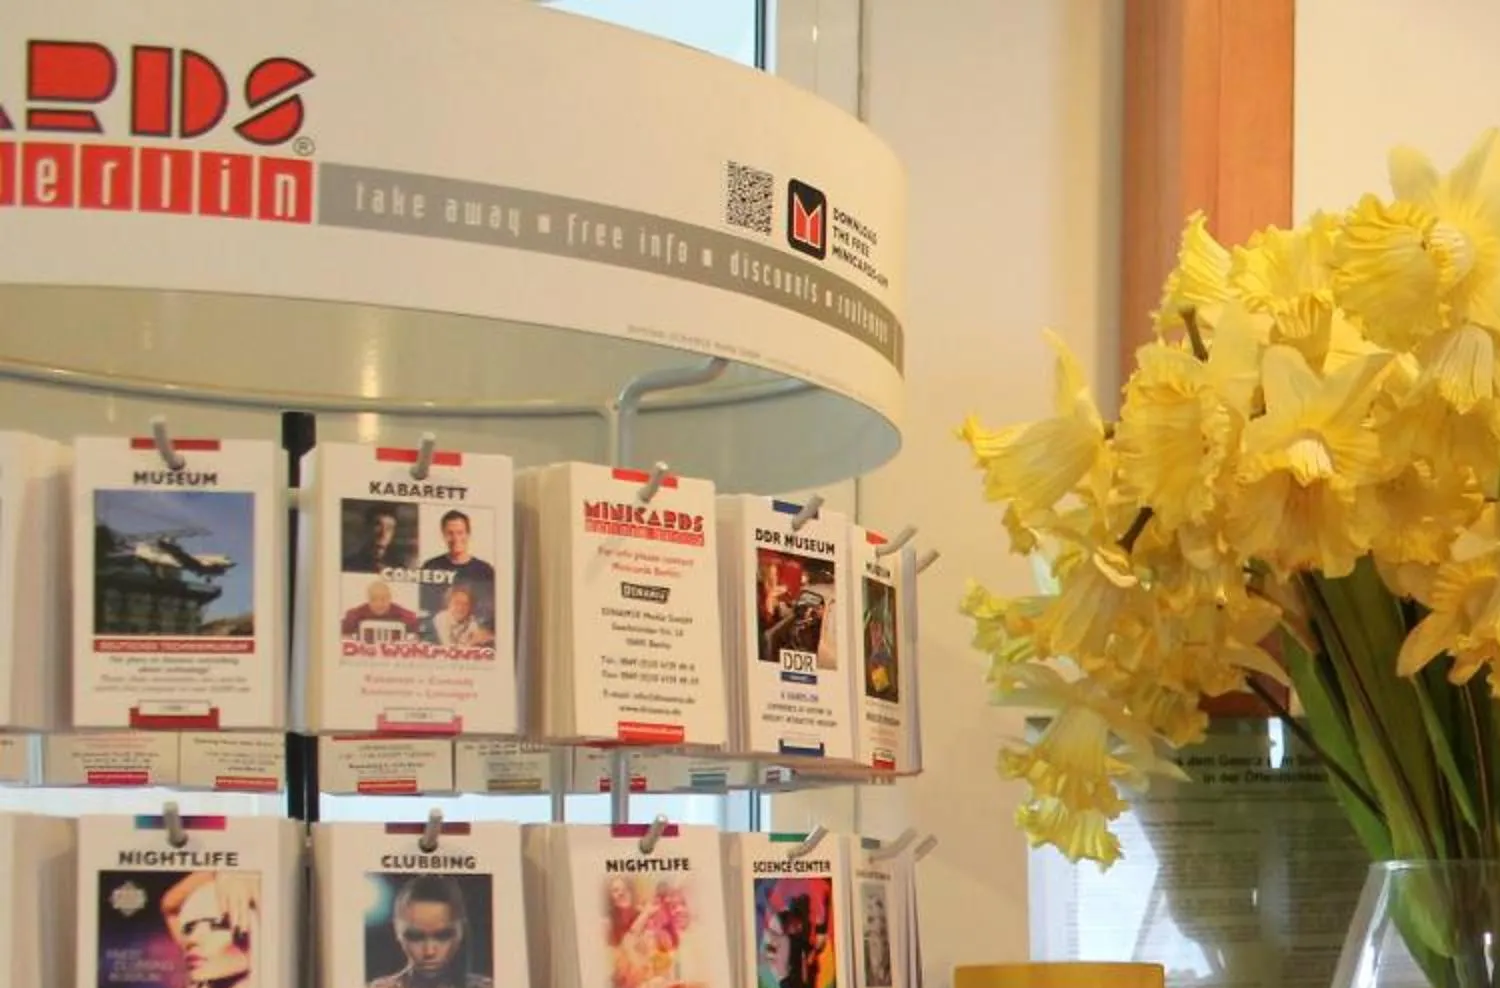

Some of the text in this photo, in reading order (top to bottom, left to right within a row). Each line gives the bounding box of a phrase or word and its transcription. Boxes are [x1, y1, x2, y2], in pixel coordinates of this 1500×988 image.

[0, 38, 316, 147] RDS
[34, 152, 297, 218] erlin
[355, 181, 425, 219] take
[445, 197, 521, 238] away
[566, 213, 623, 250] free
[639, 227, 688, 265] info
[730, 251, 817, 304] discounts
[832, 225, 870, 257] THE FREE
[133, 471, 217, 486] MUSEUM
[368, 481, 469, 501] KABARETT
[584, 500, 704, 533] MINICARDS
[755, 527, 836, 555] DDR MUSEUM
[380, 566, 457, 585] COMEDY
[783, 651, 815, 672] DDR
[118, 851, 239, 867] NIGHTLIFE
[381, 855, 477, 870] CLUBBING
[605, 858, 690, 873] NIGHTLIFE
[753, 860, 832, 874] SCIENCE CENTER
